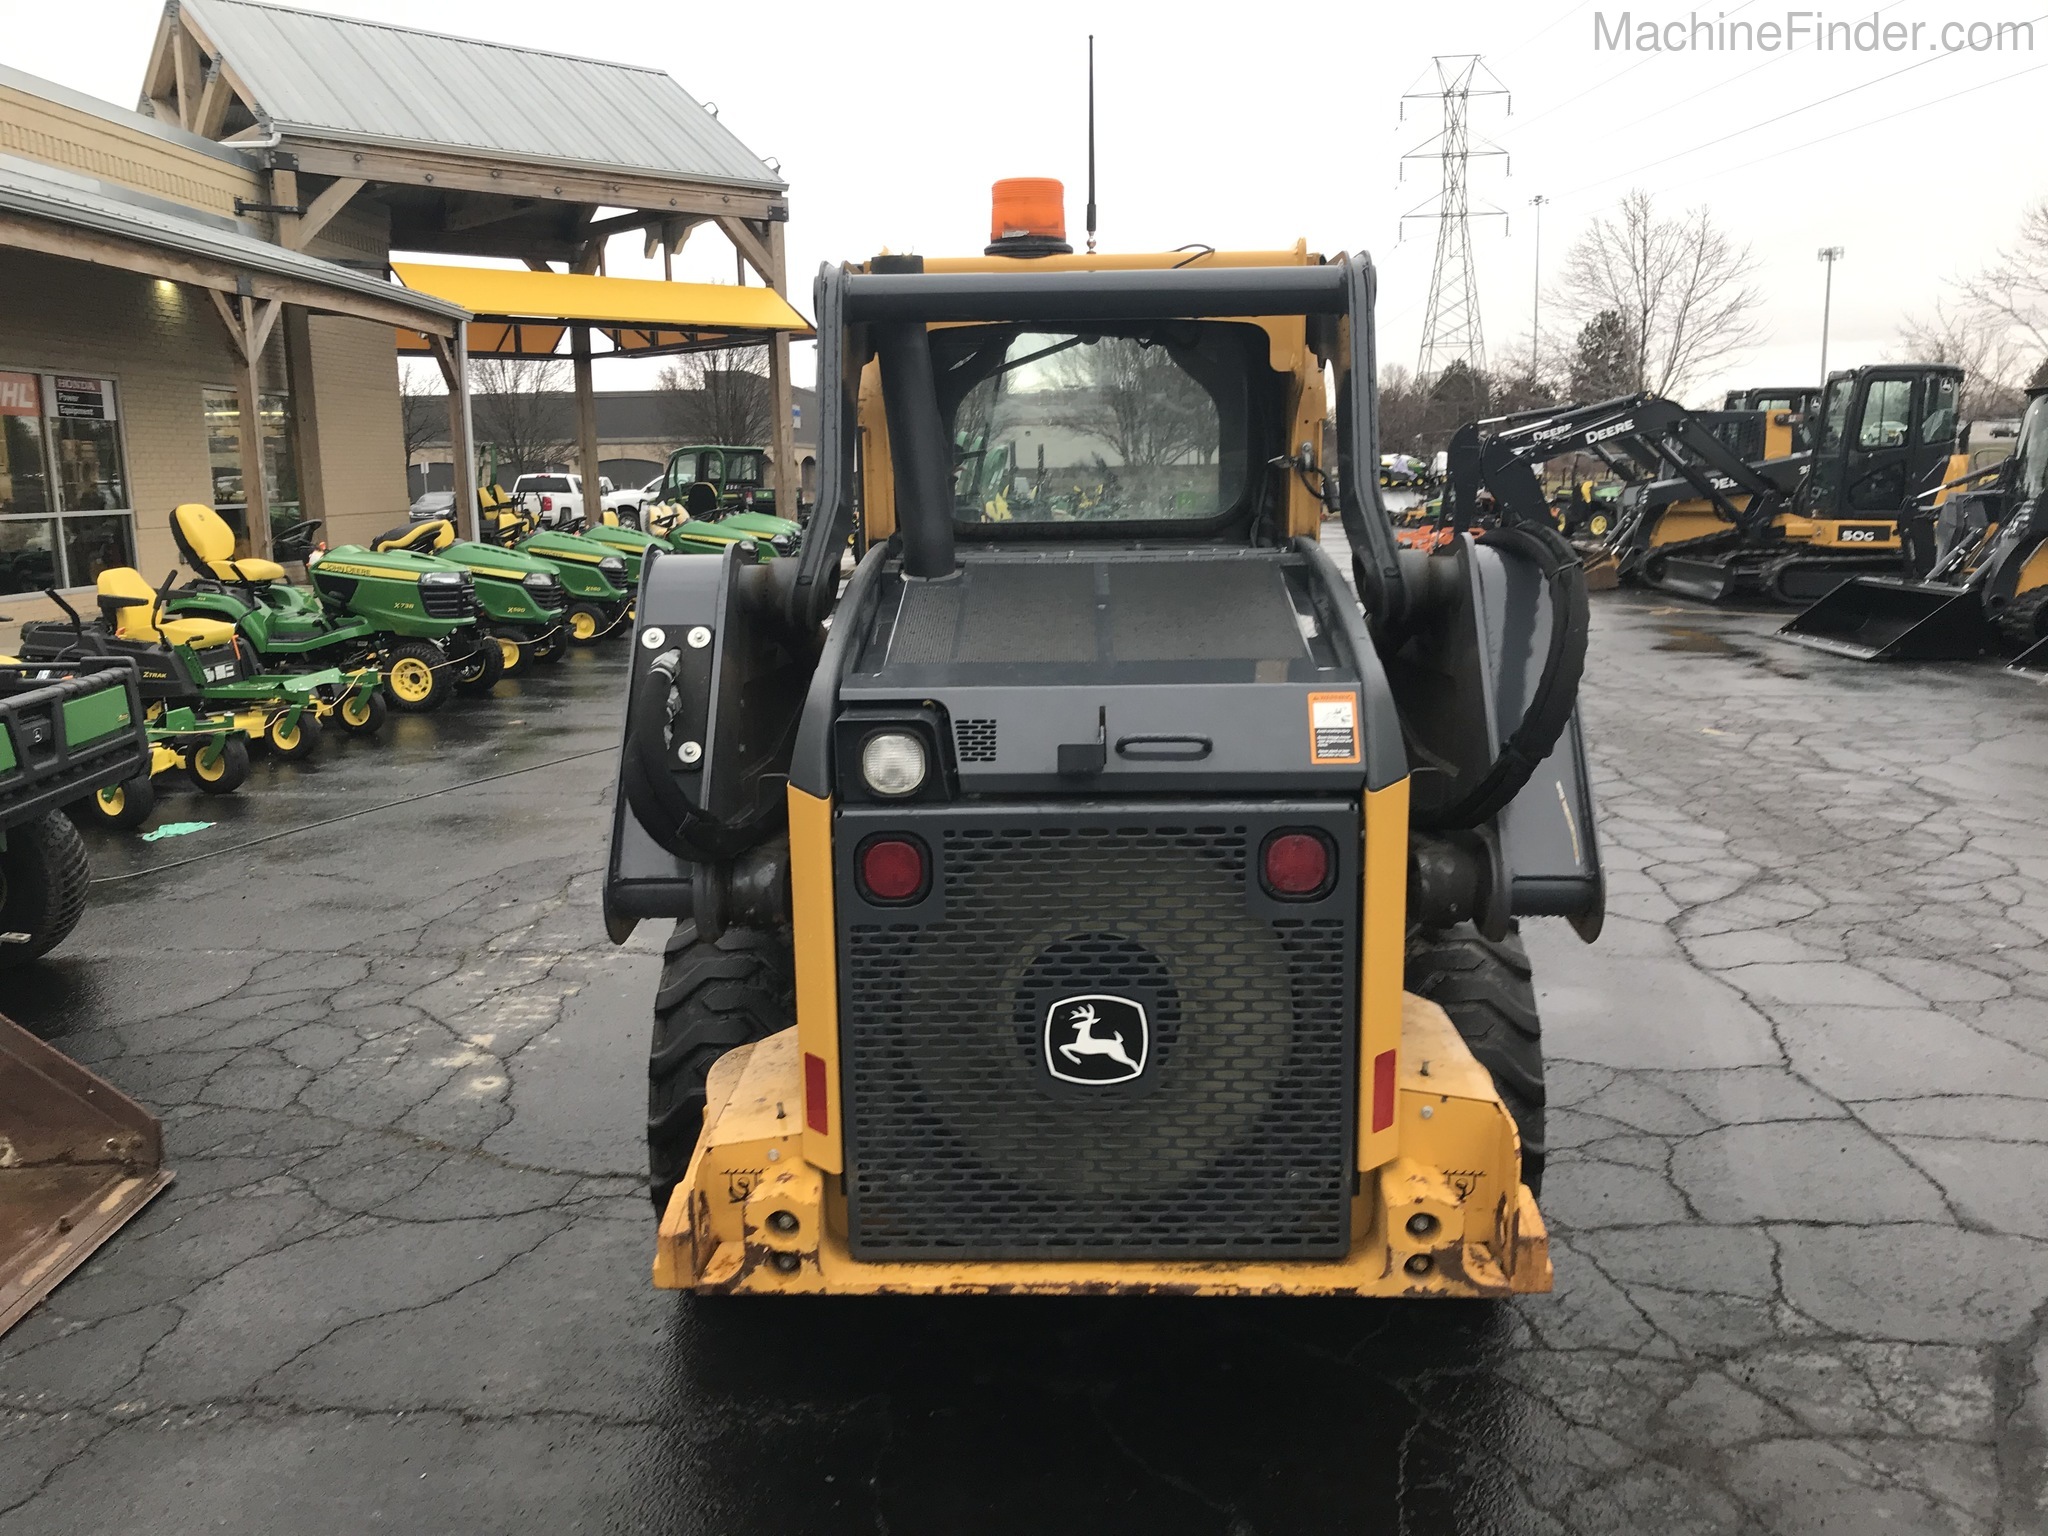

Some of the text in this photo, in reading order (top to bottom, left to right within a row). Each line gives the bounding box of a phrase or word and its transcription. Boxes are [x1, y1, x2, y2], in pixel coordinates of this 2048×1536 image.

[57, 379, 96, 391] HONDA
[0, 381, 33, 408] HL
[59, 392, 79, 403] Power
[1584, 418, 1635, 445] DEERE
[1841, 529, 1875, 542] 50G
